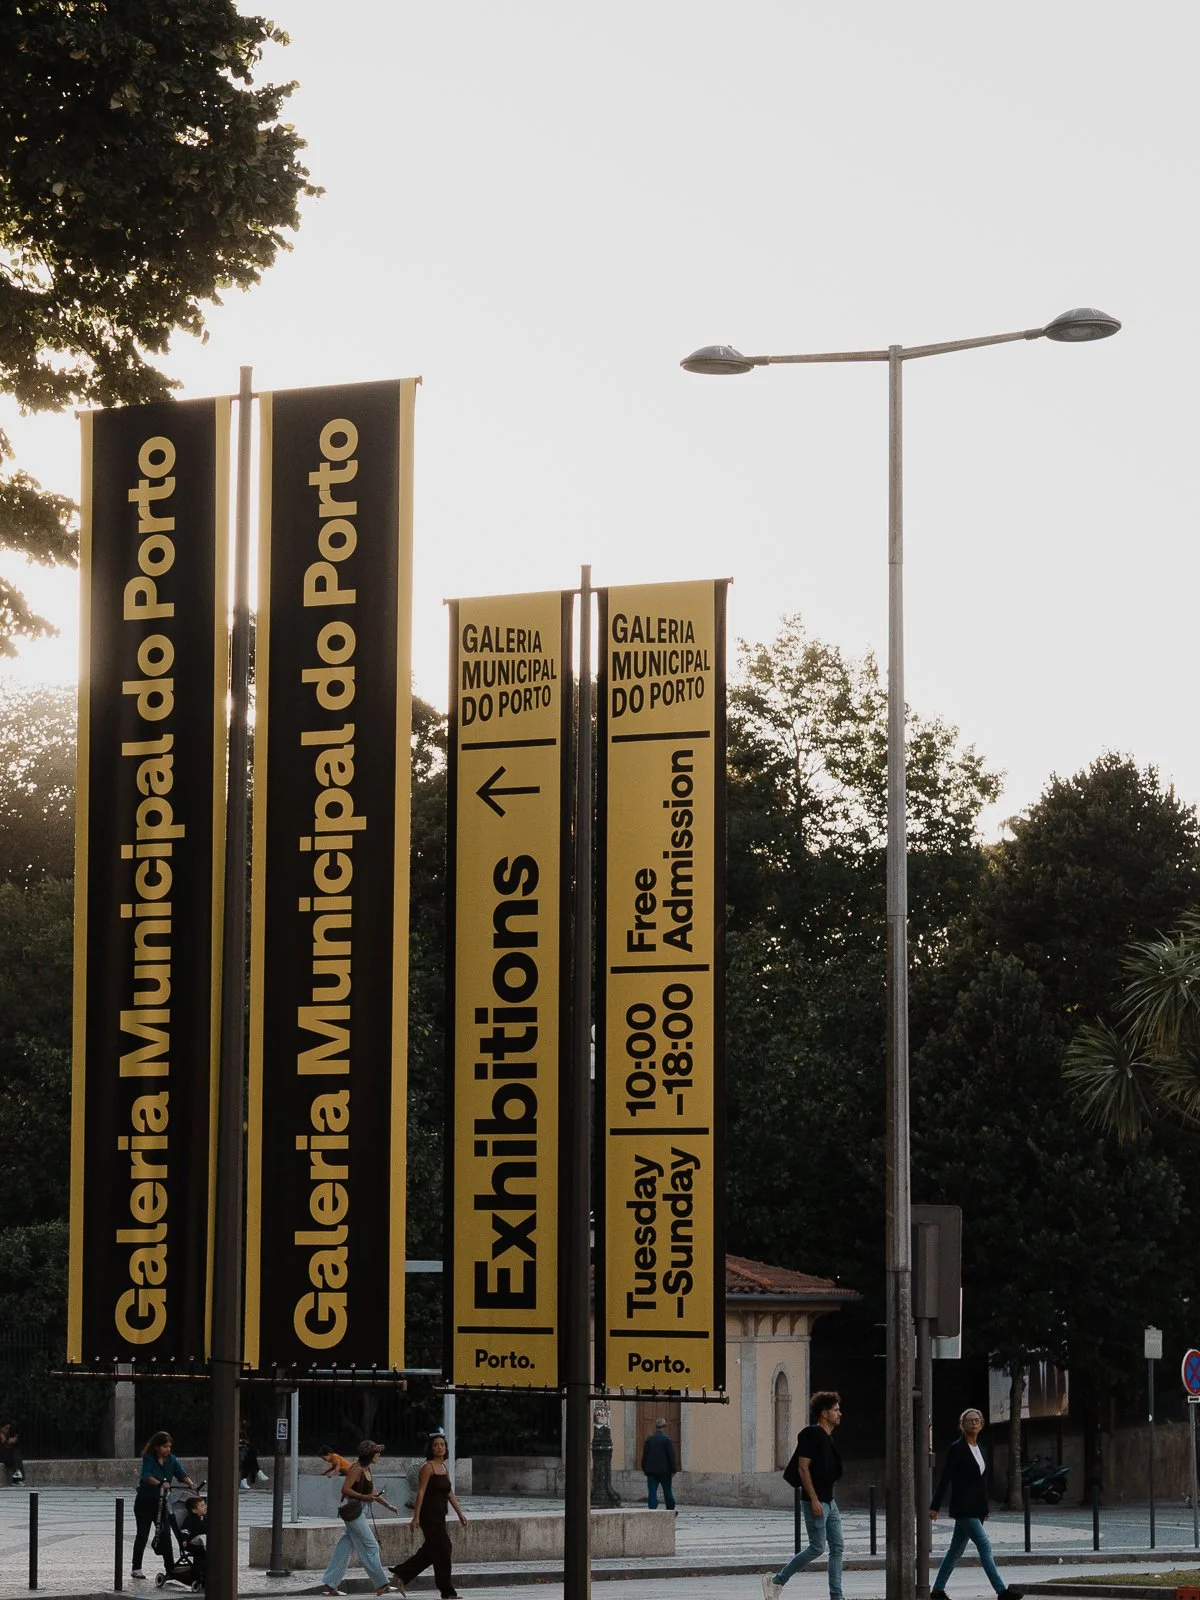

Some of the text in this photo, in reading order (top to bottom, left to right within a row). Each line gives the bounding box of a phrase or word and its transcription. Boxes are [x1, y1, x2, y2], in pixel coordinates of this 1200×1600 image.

[463, 624, 542, 653] GALERIA
[612, 614, 695, 643] GALERIA
[462, 659, 556, 690] MUNICIPAL
[612, 650, 710, 681] MUNICIPAL
[462, 685, 551, 726] DO PORTO
[612, 676, 704, 718] DO PORTO
[663, 750, 693, 952] Admission
[115, 436, 185, 1344] Galeria Municipal do Porto
[294, 419, 366, 1349] Galeria Municipal do Porto
[627, 869, 656, 952] Free
[626, 1003, 656, 1116] 10:00
[474, 855, 539, 1309] Exhibitions
[626, 1154, 664, 1318] Tuesday
[476, 1349, 535, 1369] Porto.
[629, 1353, 690, 1373] Porto.
